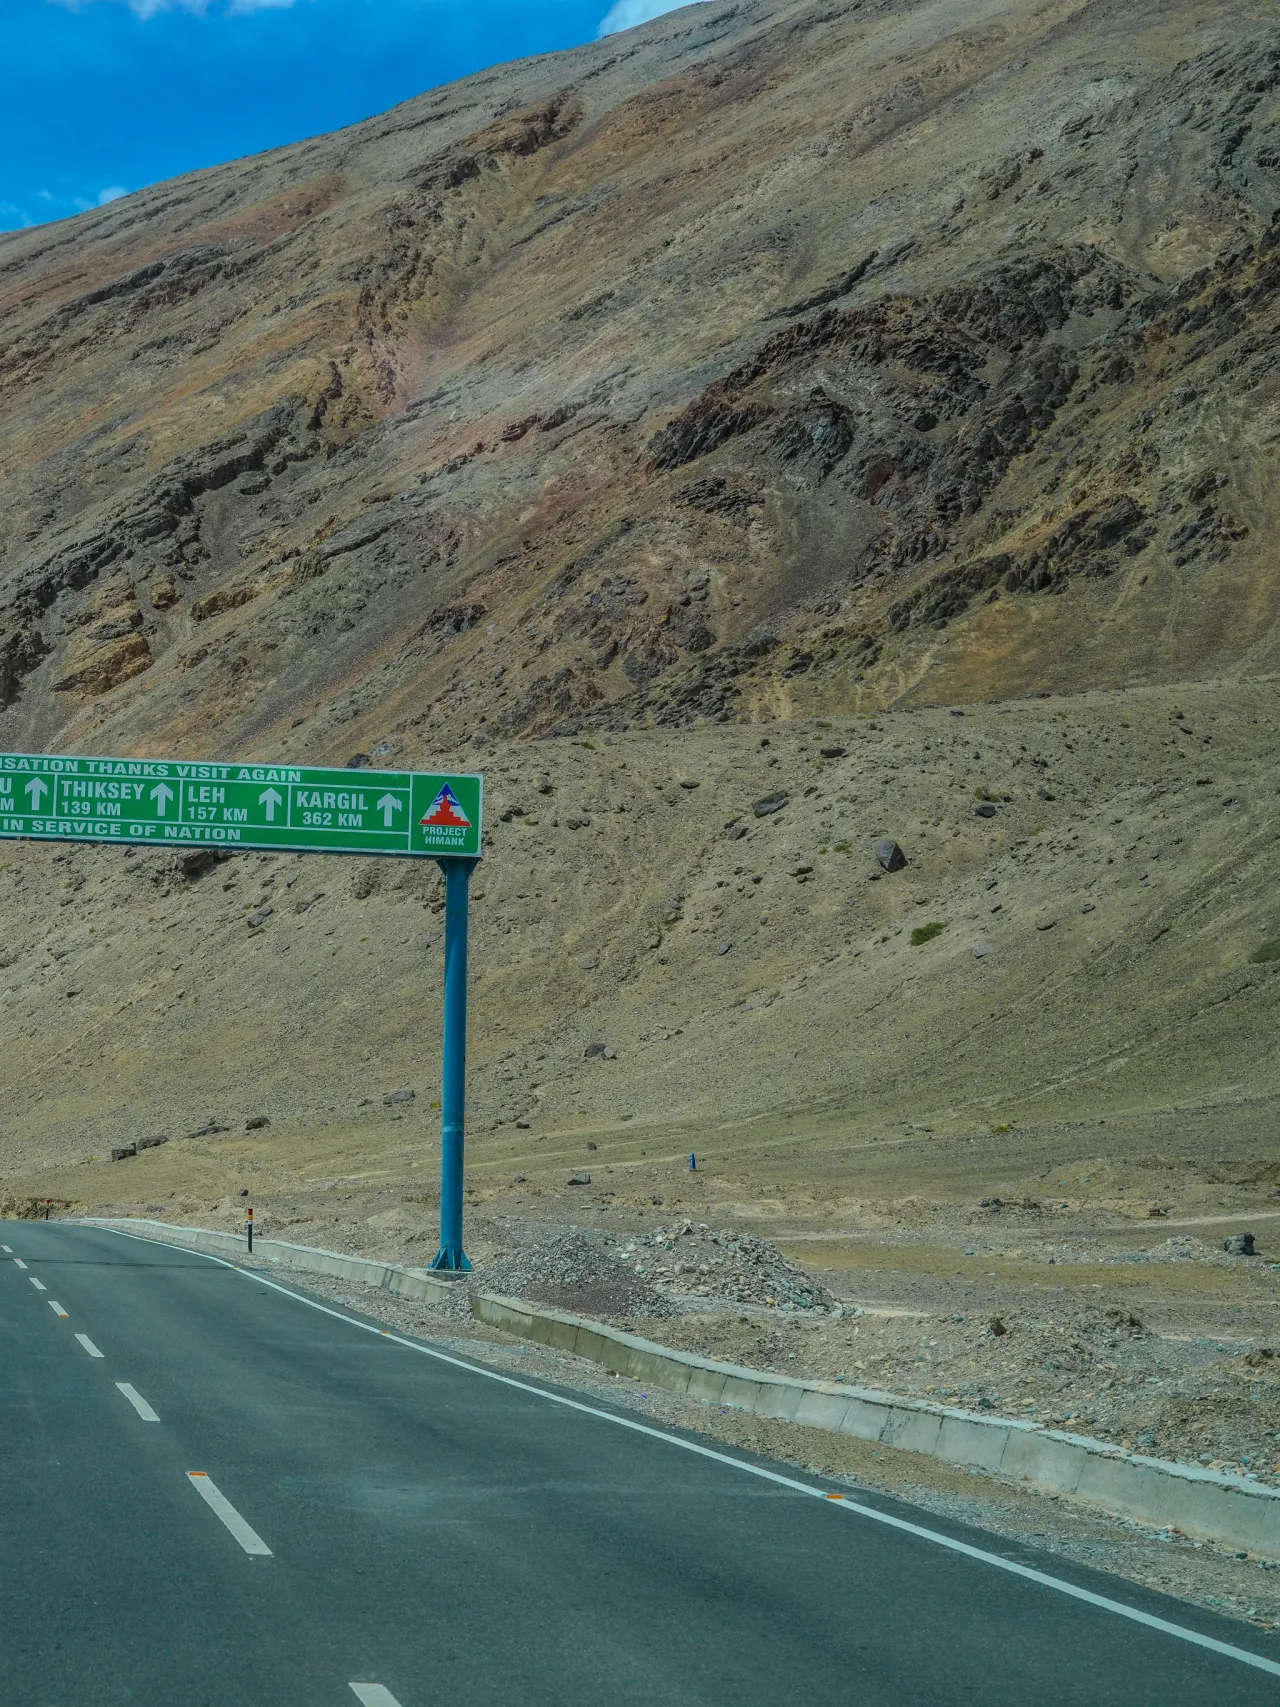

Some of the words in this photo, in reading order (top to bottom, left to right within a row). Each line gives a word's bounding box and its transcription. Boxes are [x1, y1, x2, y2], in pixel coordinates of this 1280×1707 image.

[86, 761, 169, 776] THANKS
[176, 765, 231, 779] VISIT
[238, 768, 301, 782] AGAIN
[60, 780, 145, 800] THIKSEY
[188, 785, 225, 804] LEH
[61, 801, 91, 815] 139
[96, 802, 121, 816] KM
[296, 791, 369, 810] KARGIL
[187, 806, 217, 820] 157
[223, 808, 248, 822] KM
[302, 811, 332, 826] 362
[338, 813, 362, 827] KM
[3, 819, 24, 831] IN
[32, 820, 121, 835] SERVICE
[129, 824, 156, 836] OF
[164, 826, 241, 840] NATION
[423, 827, 467, 836] PROJECT
[425, 836, 465, 845] HIMANK
